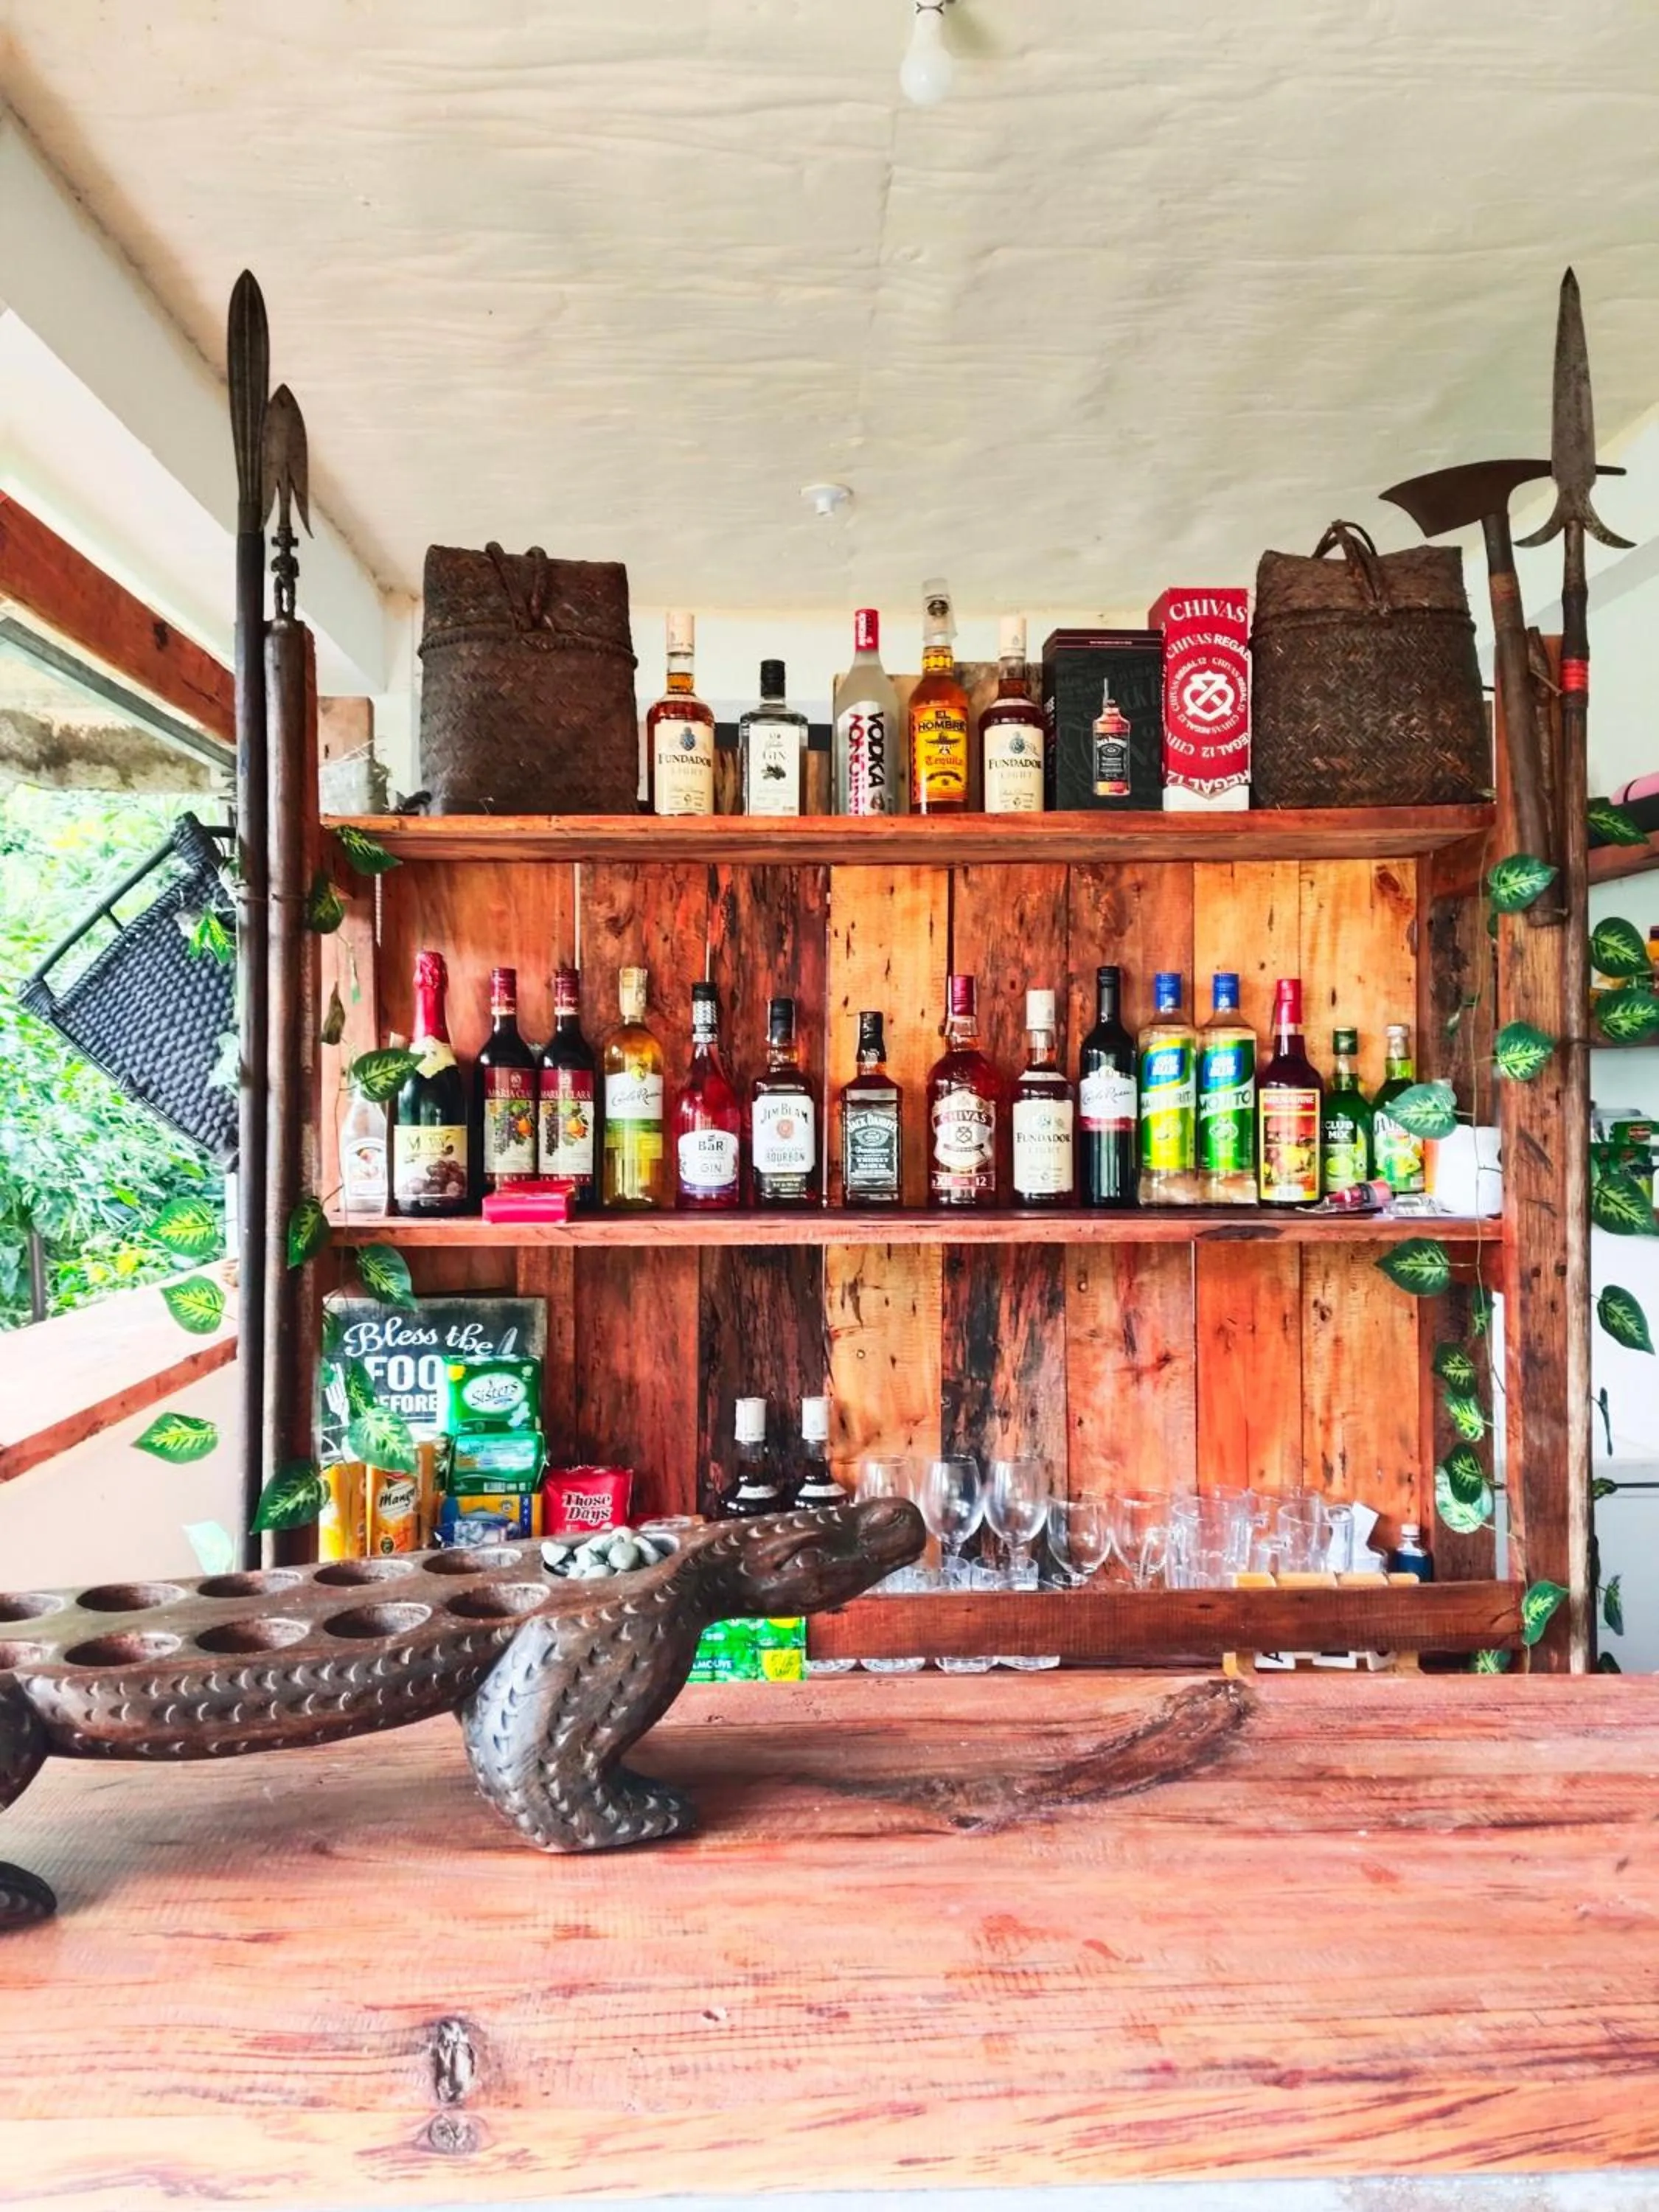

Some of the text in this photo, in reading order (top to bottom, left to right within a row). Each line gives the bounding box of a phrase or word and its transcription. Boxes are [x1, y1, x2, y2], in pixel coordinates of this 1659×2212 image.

[1169, 599, 1248, 623] CHIVAS
[1166, 633, 1212, 659] CHIVAS
[935, 710, 951, 719] EL
[919, 720, 966, 731] HOMBRE
[868, 711, 885, 788] VODKA
[1201, 746, 1215, 758] 12
[658, 754, 712, 768] FUNDADOR
[989, 759, 1041, 769] FUNDADOR
[760, 1103, 808, 1124] JIM BEAM
[940, 1111, 987, 1123] CHIVAS
[1325, 1121, 1354, 1130] CLUB
[1017, 1133, 1071, 1143] FUNDADOR
[1328, 1131, 1349, 1139] MIX
[766, 1152, 806, 1162] BOURBON
[975, 1176, 987, 1186] 12
[344, 1316, 493, 1357] Bless the
[364, 1355, 442, 1391] FOO
[563, 1493, 611, 1506] Those
[567, 1506, 611, 1523] Days
